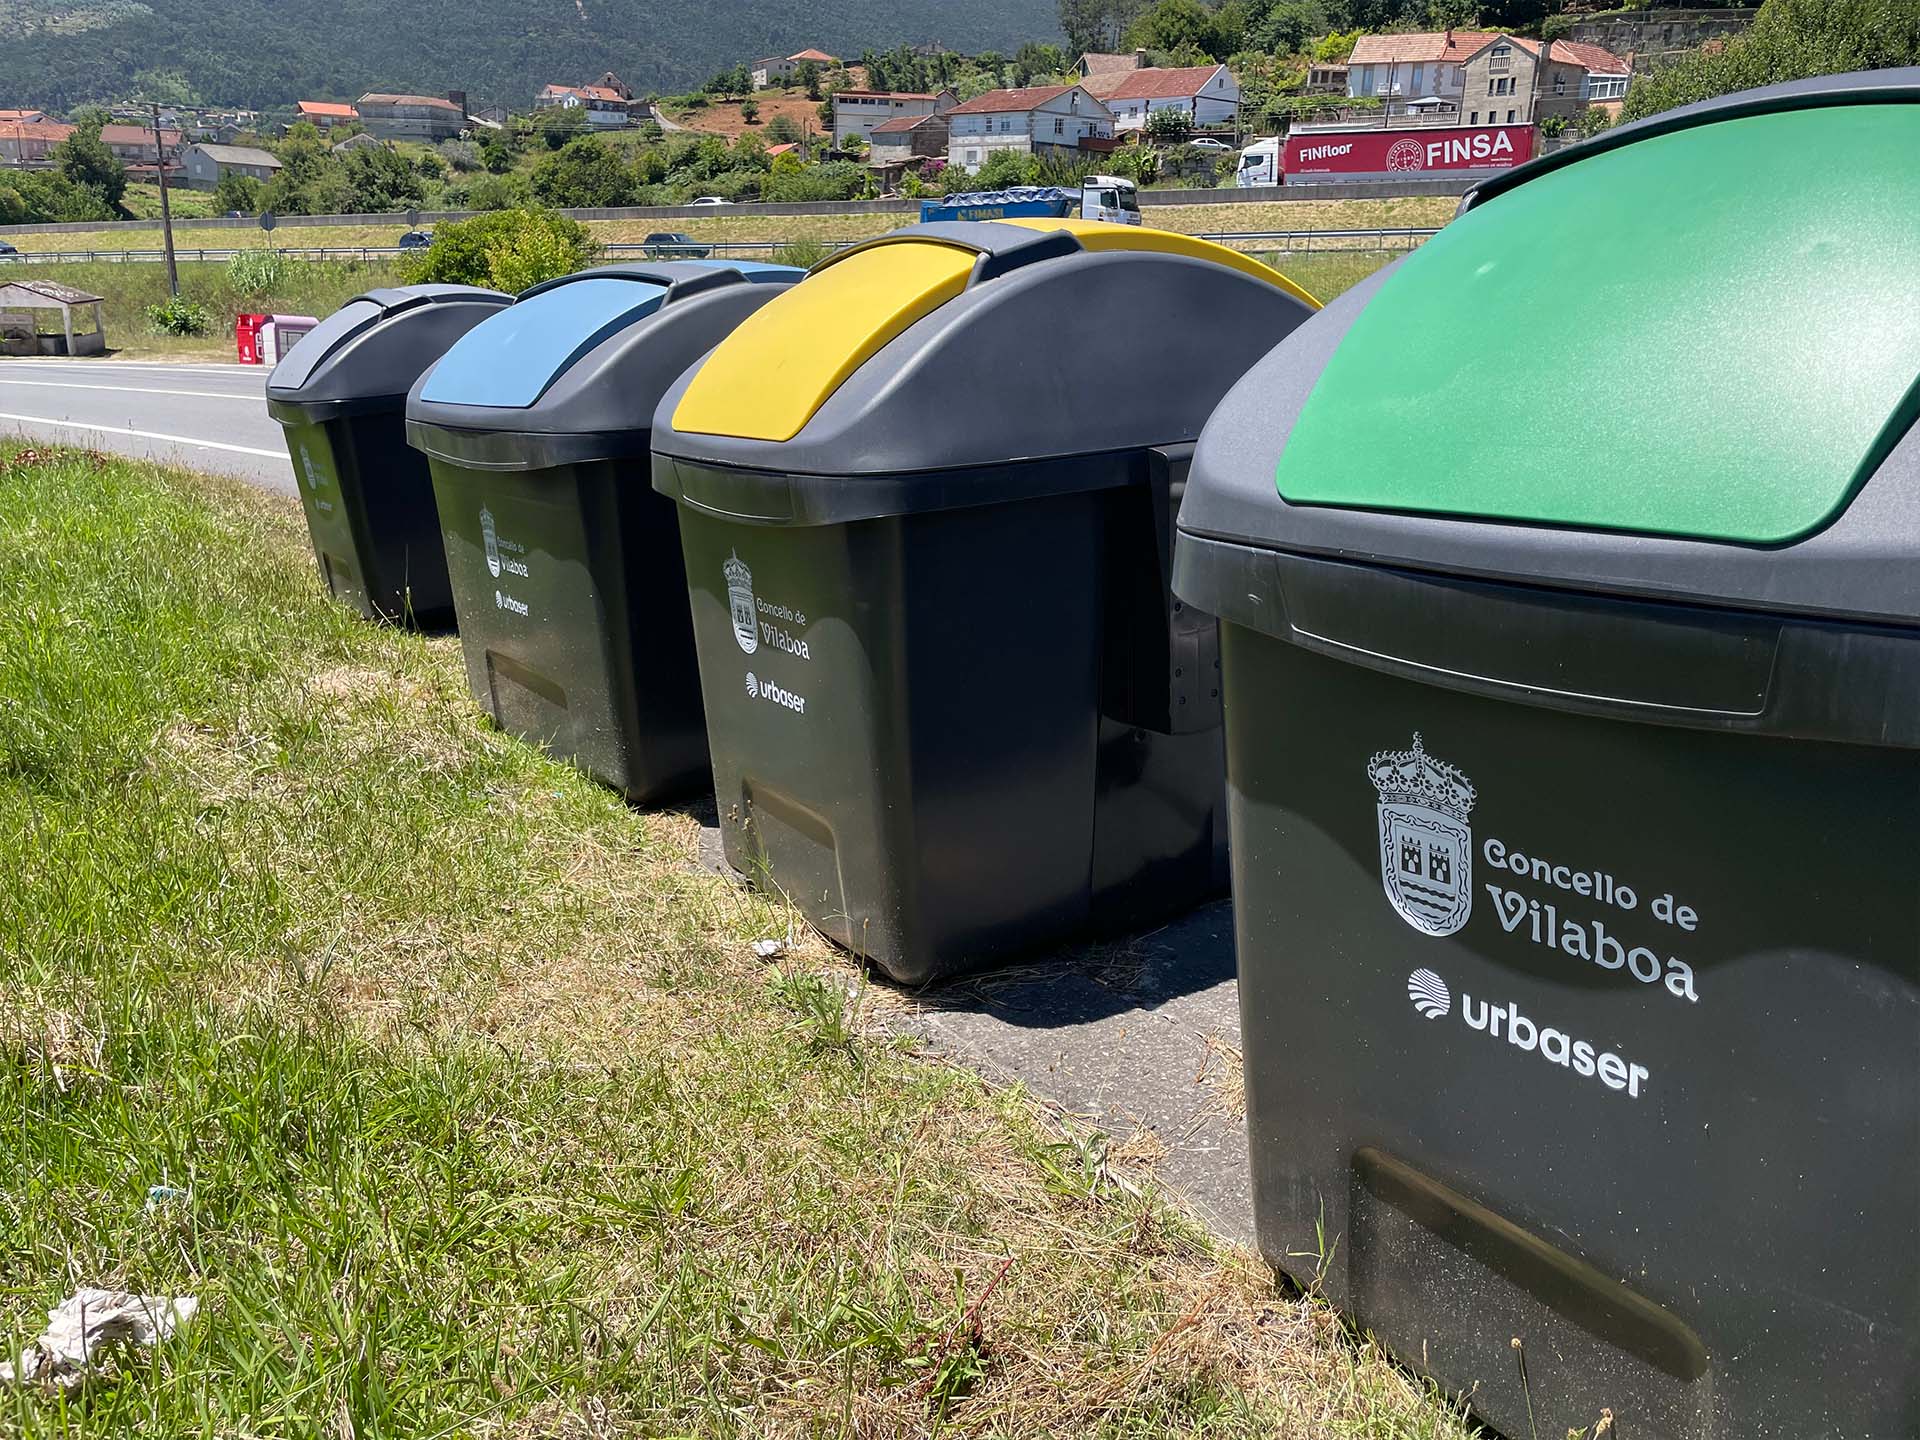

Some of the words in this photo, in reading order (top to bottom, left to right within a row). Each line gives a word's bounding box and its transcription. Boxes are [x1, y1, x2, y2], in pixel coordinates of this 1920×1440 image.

[1299, 143, 1353, 163] FINfloor
[1426, 130, 1514, 167] FINSA
[756, 597, 794, 621] Concello
[795, 610, 806, 627] de
[759, 621, 811, 661] Vilaboa
[759, 680, 807, 714] urbaser
[1483, 838, 1638, 911] Concello
[1650, 893, 1699, 932] de
[1485, 883, 1700, 1003] Vilaboa
[1462, 993, 1650, 1099] urbaser
